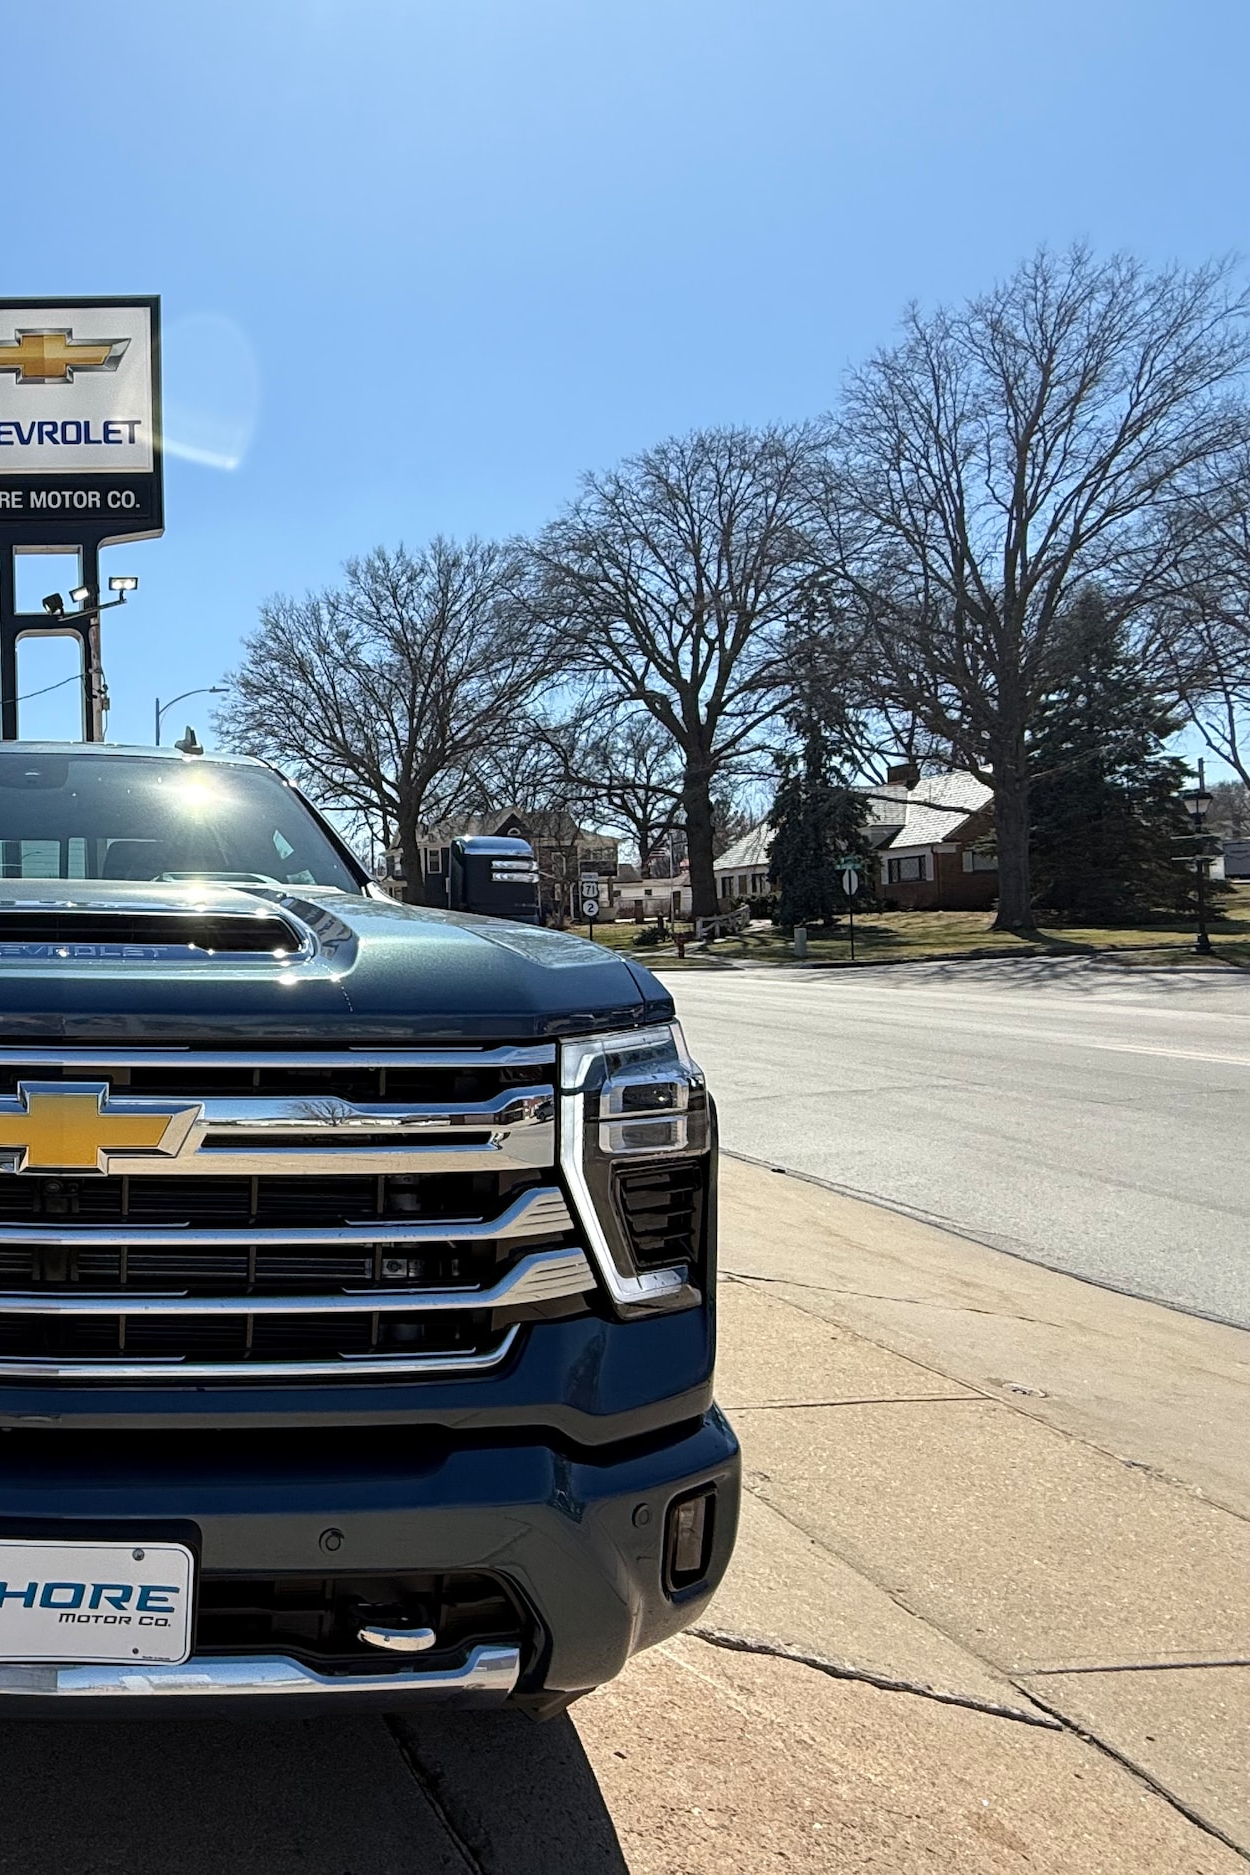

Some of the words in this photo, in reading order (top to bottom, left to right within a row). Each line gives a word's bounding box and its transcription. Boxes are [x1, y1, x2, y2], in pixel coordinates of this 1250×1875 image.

[30, 491, 101, 509] MOTOR
[107, 490, 141, 509] CO.
[586, 885, 595, 895] 71
[587, 903, 594, 913] 2
[58, 1613, 132, 1625] MOTOR
